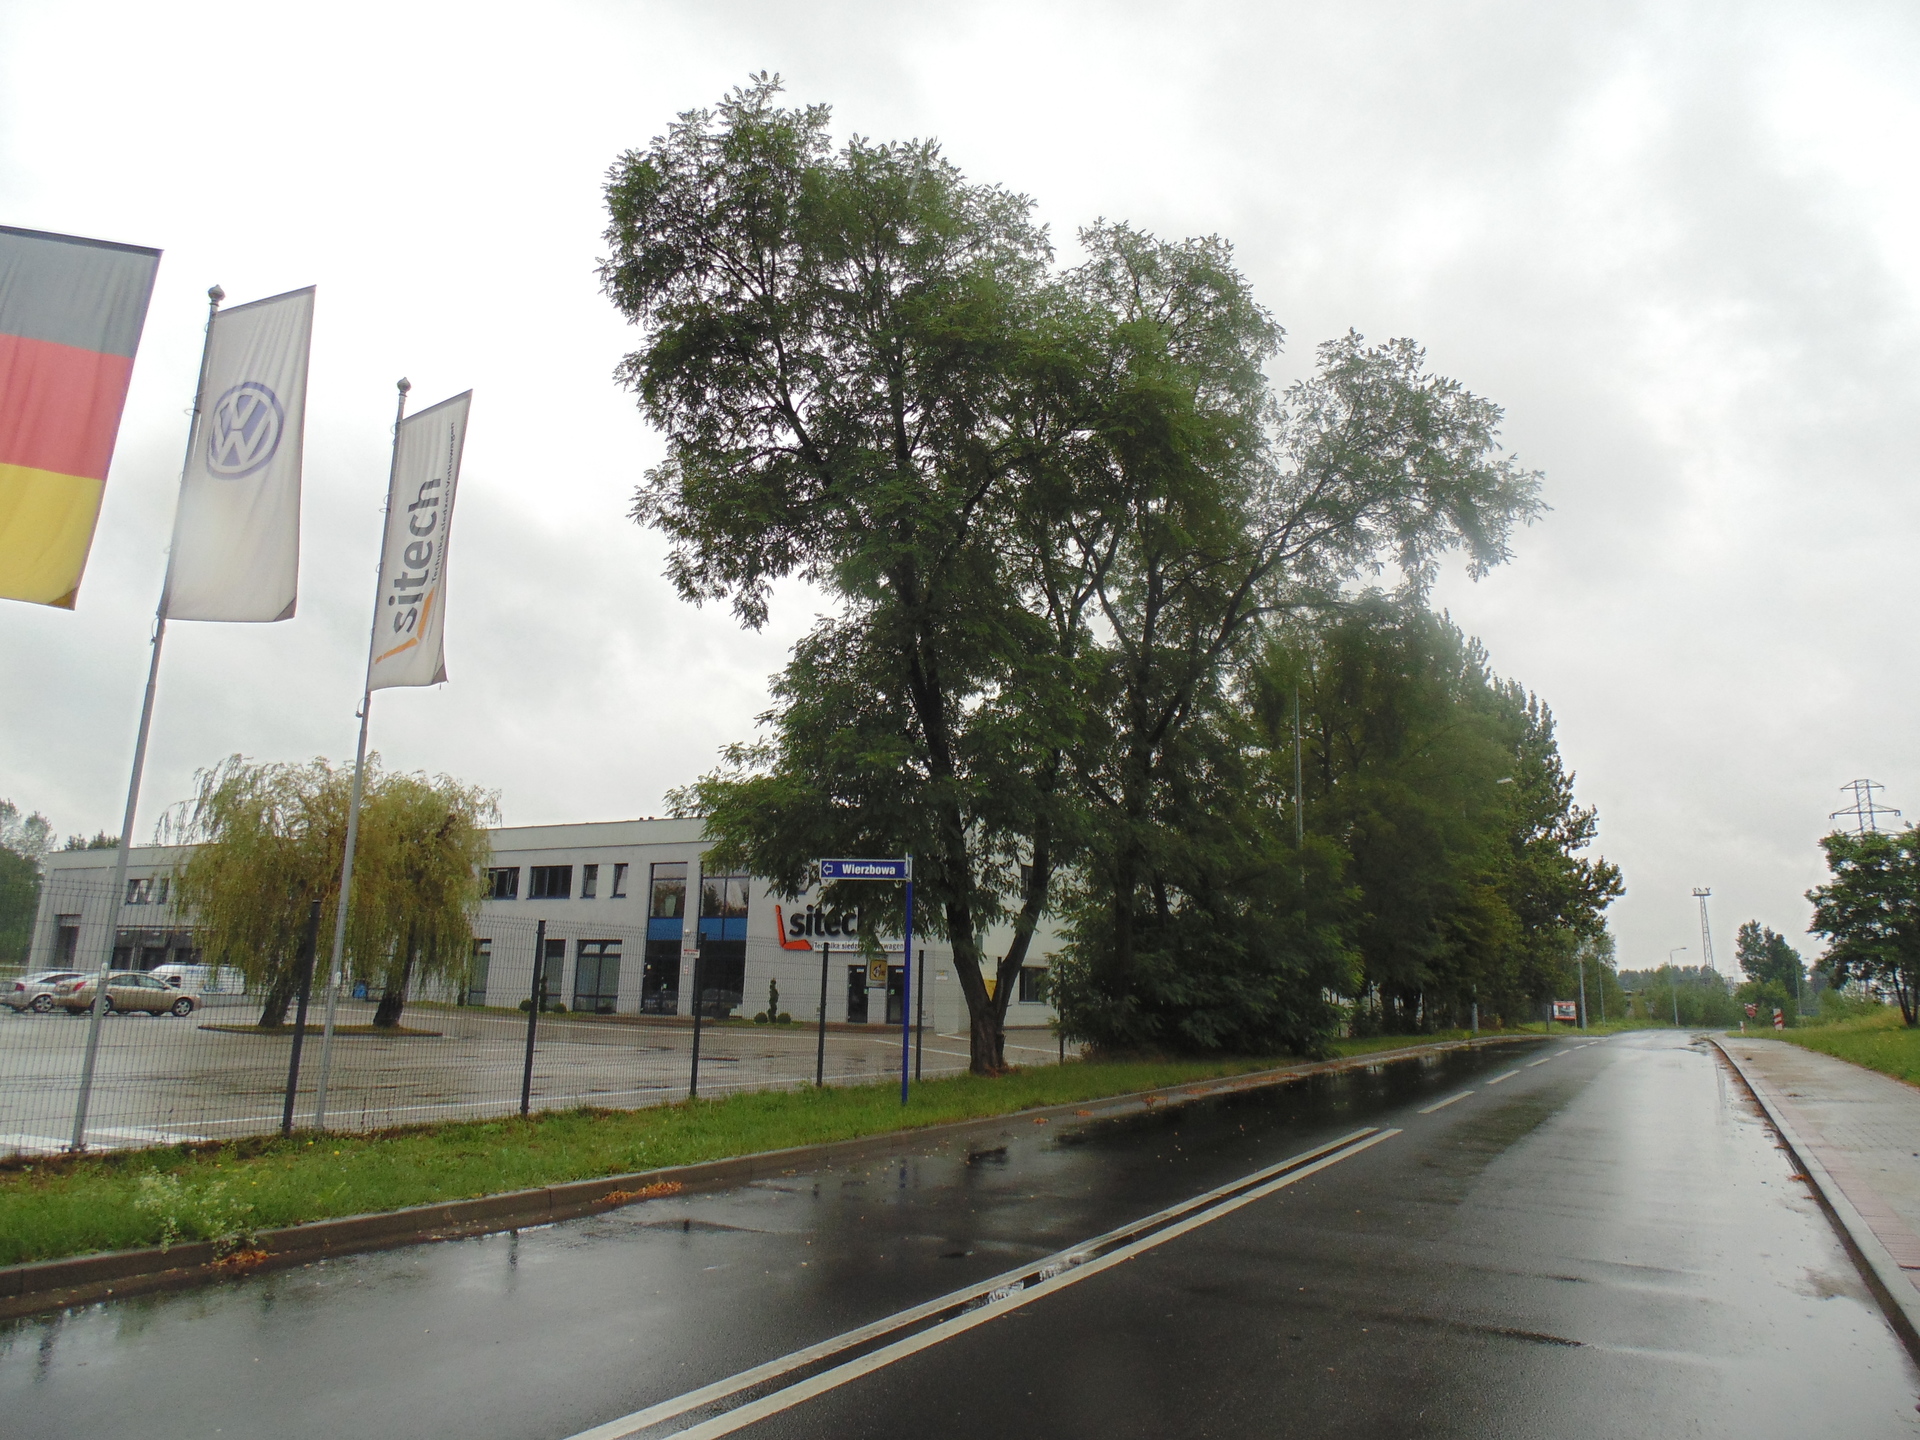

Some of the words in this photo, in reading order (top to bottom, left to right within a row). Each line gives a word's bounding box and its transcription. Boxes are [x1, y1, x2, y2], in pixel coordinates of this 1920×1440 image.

[388, 477, 442, 634] sitech
[431, 534, 444, 583] Technika
[842, 863, 896, 875] Wierzbowa
[789, 904, 863, 937] sitec
